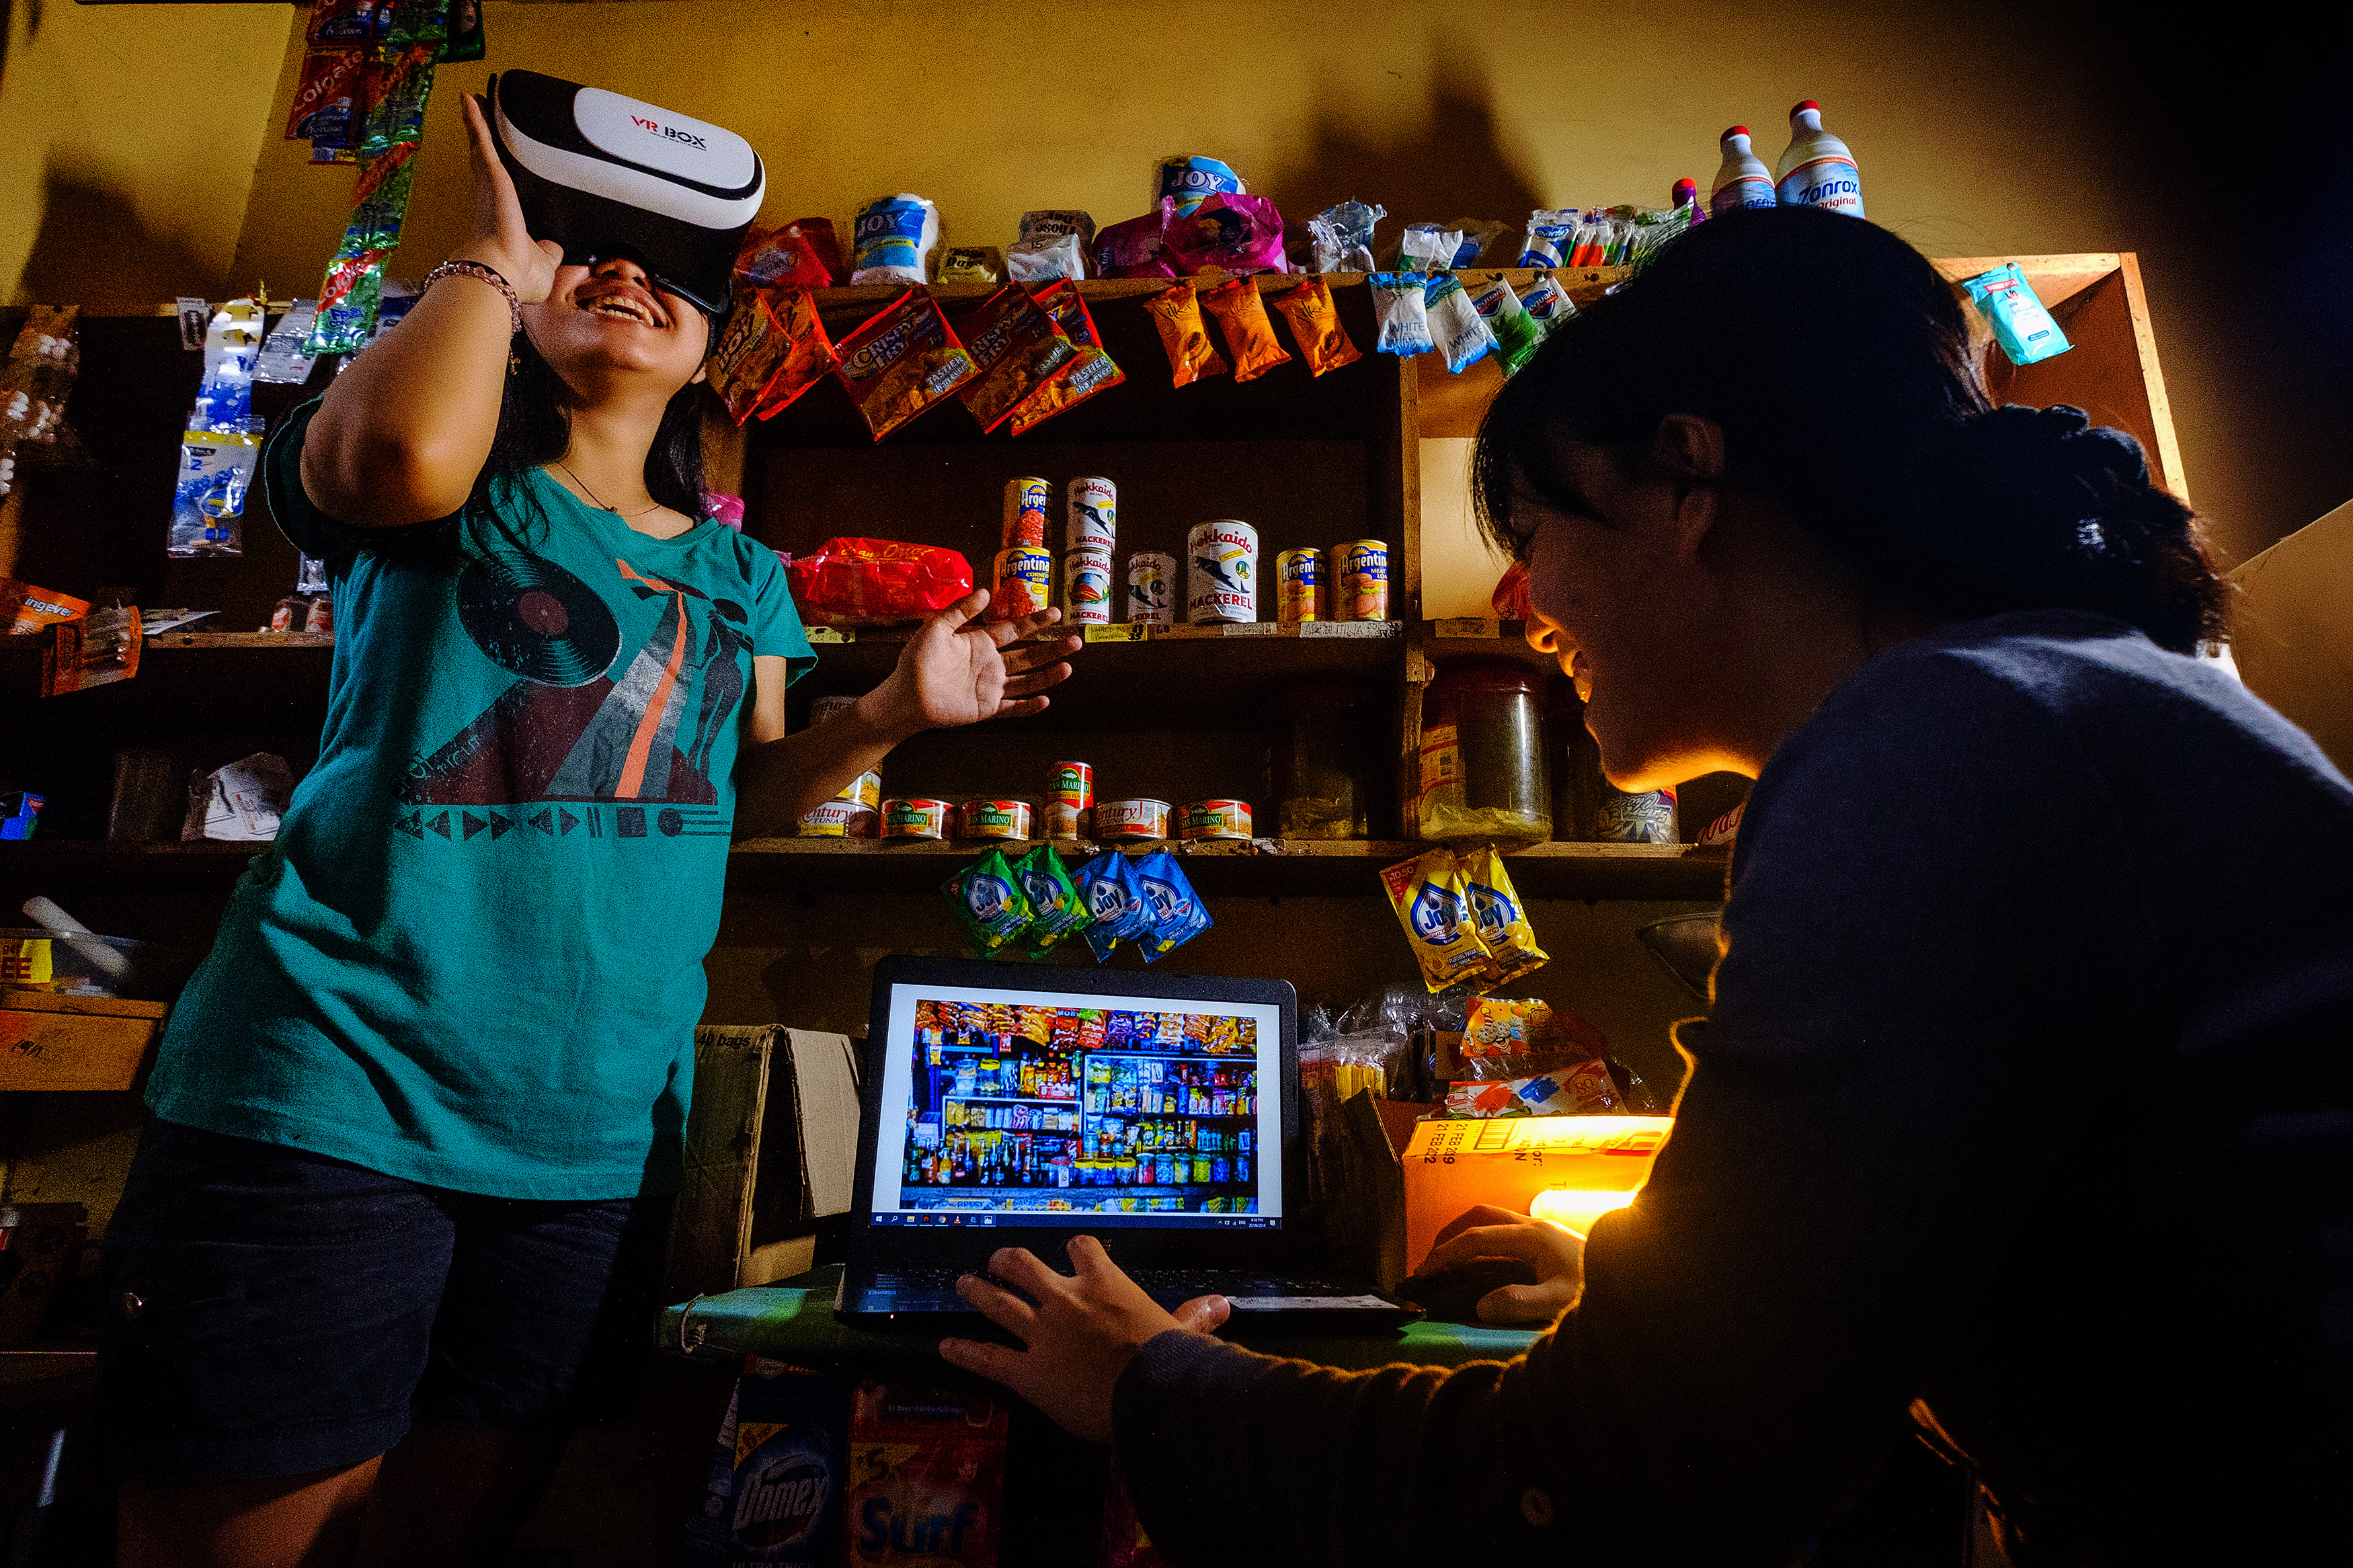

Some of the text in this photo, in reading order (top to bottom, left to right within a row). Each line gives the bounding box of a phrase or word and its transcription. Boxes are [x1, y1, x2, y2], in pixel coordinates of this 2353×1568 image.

[631, 115, 658, 132] VR
[665, 126, 706, 148] BOX
[1171, 170, 1226, 190] JOY
[1798, 181, 1858, 206] Zonrox
[1817, 195, 1858, 210] original
[856, 213, 900, 237] JOY
[970, 308, 1016, 357] RISPY
[1389, 321, 1426, 334] WHITE
[1449, 325, 1484, 349] WHITE
[852, 312, 916, 369] CRISPY
[874, 336, 908, 369] FRY
[978, 336, 1010, 367] FRY
[926, 356, 965, 386] TASTIER
[1069, 355, 1109, 386] TASTIER
[1189, 528, 1252, 554] Hokkaido
[1189, 593, 1252, 612] MACKEREL
[895, 813, 927, 824] MARINO
[980, 814, 1011, 825] MARINO
[1192, 815, 1222, 826] MARINO
[1094, 889, 1123, 915] JOY
[1151, 891, 1172, 911] OY
[1424, 903, 1458, 930] JOY
[697, 1032, 751, 1050] 40 bags
[1437, 1123, 1449, 1134] 21
[1457, 1123, 1469, 1134] 21
[1431, 1133, 1445, 1149] FEB
[1451, 1133, 1465, 1149] FEB
[733, 1471, 828, 1530] Domex
[859, 1497, 980, 1555] Surf
